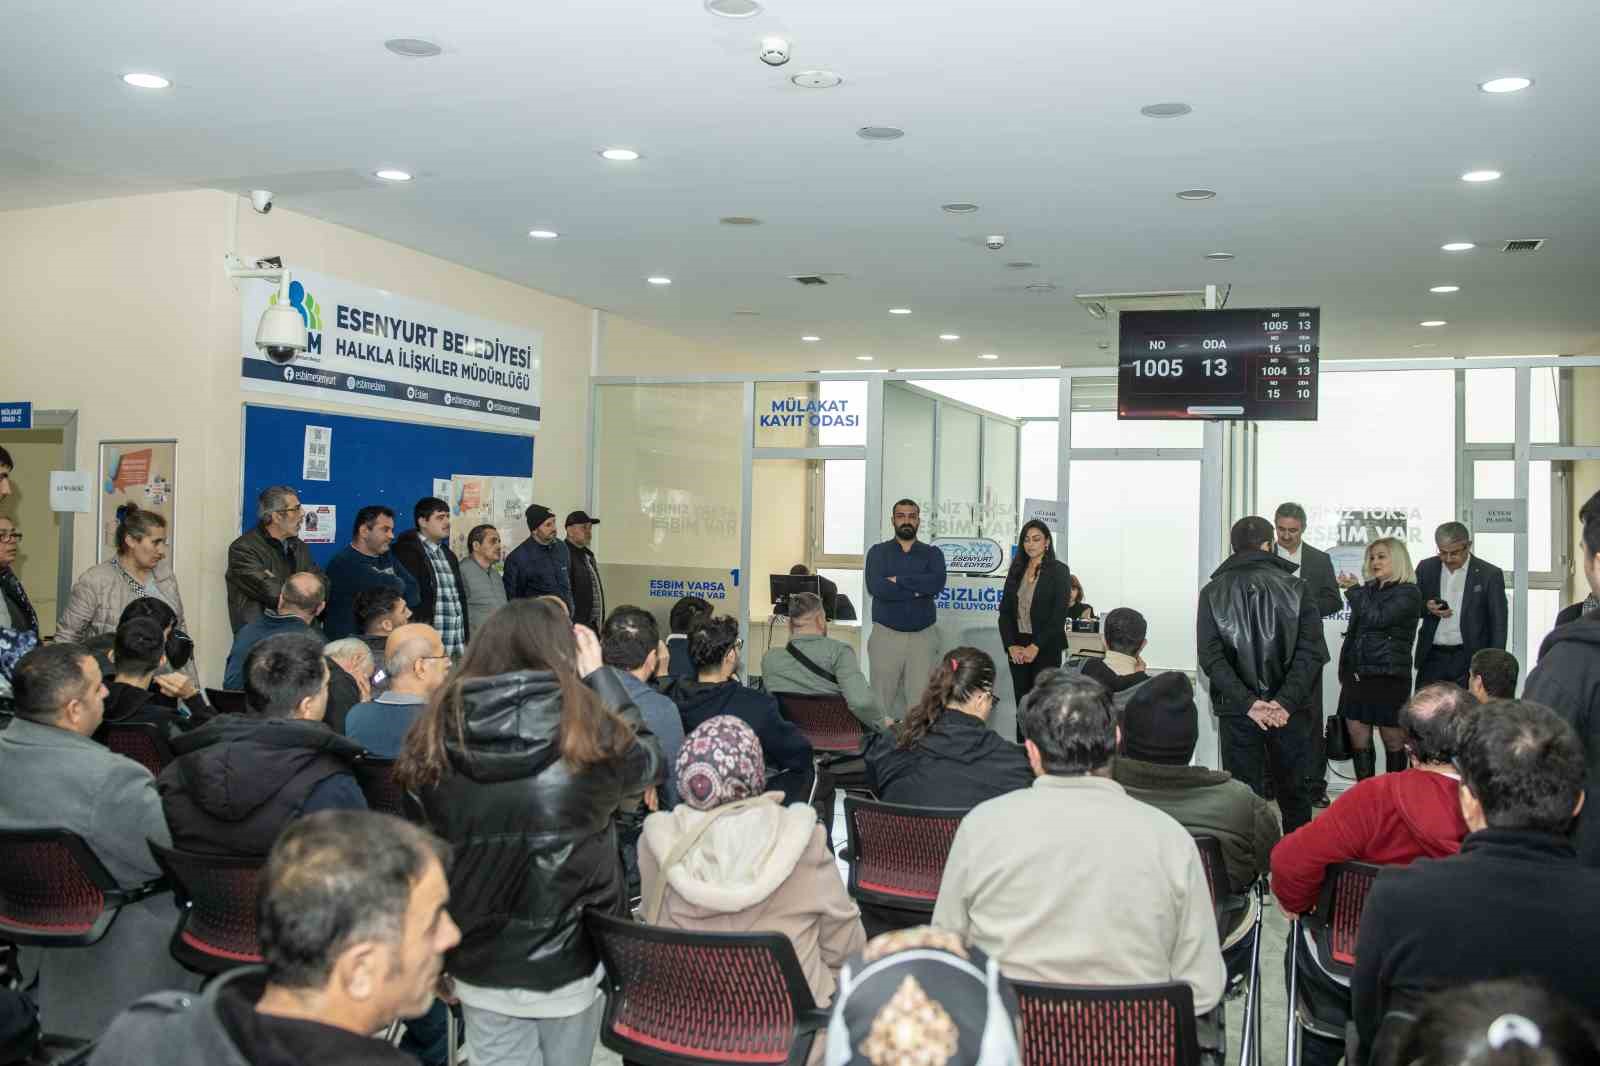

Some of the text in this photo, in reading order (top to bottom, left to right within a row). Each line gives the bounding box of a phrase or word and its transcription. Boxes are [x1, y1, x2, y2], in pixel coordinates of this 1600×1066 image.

[1263, 321, 1311, 331] 1005 13
[337, 304, 438, 348] ESENYURT
[443, 330, 531, 369] BELEDİYESİ
[1149, 339, 1227, 351] NO ODA
[1268, 344, 1311, 353] 16 10
[336, 338, 395, 366] HALKLA
[398, 347, 459, 377] İLİŞKİLER
[461, 362, 531, 391] MÜDÜRLÜĞÜ
[1131, 358, 1228, 377] 1005 13
[1262, 366, 1311, 376] 1004 13
[1267, 389, 1310, 399] 15 10
[771, 397, 849, 412] MÜLAKAT
[760, 414, 860, 427] KAYIT ODASI
[730, 568, 740, 587] 1
[687, 581, 726, 592] VARSA
[650, 590, 685, 599] HERKES
[707, 592, 726, 600] VAR
